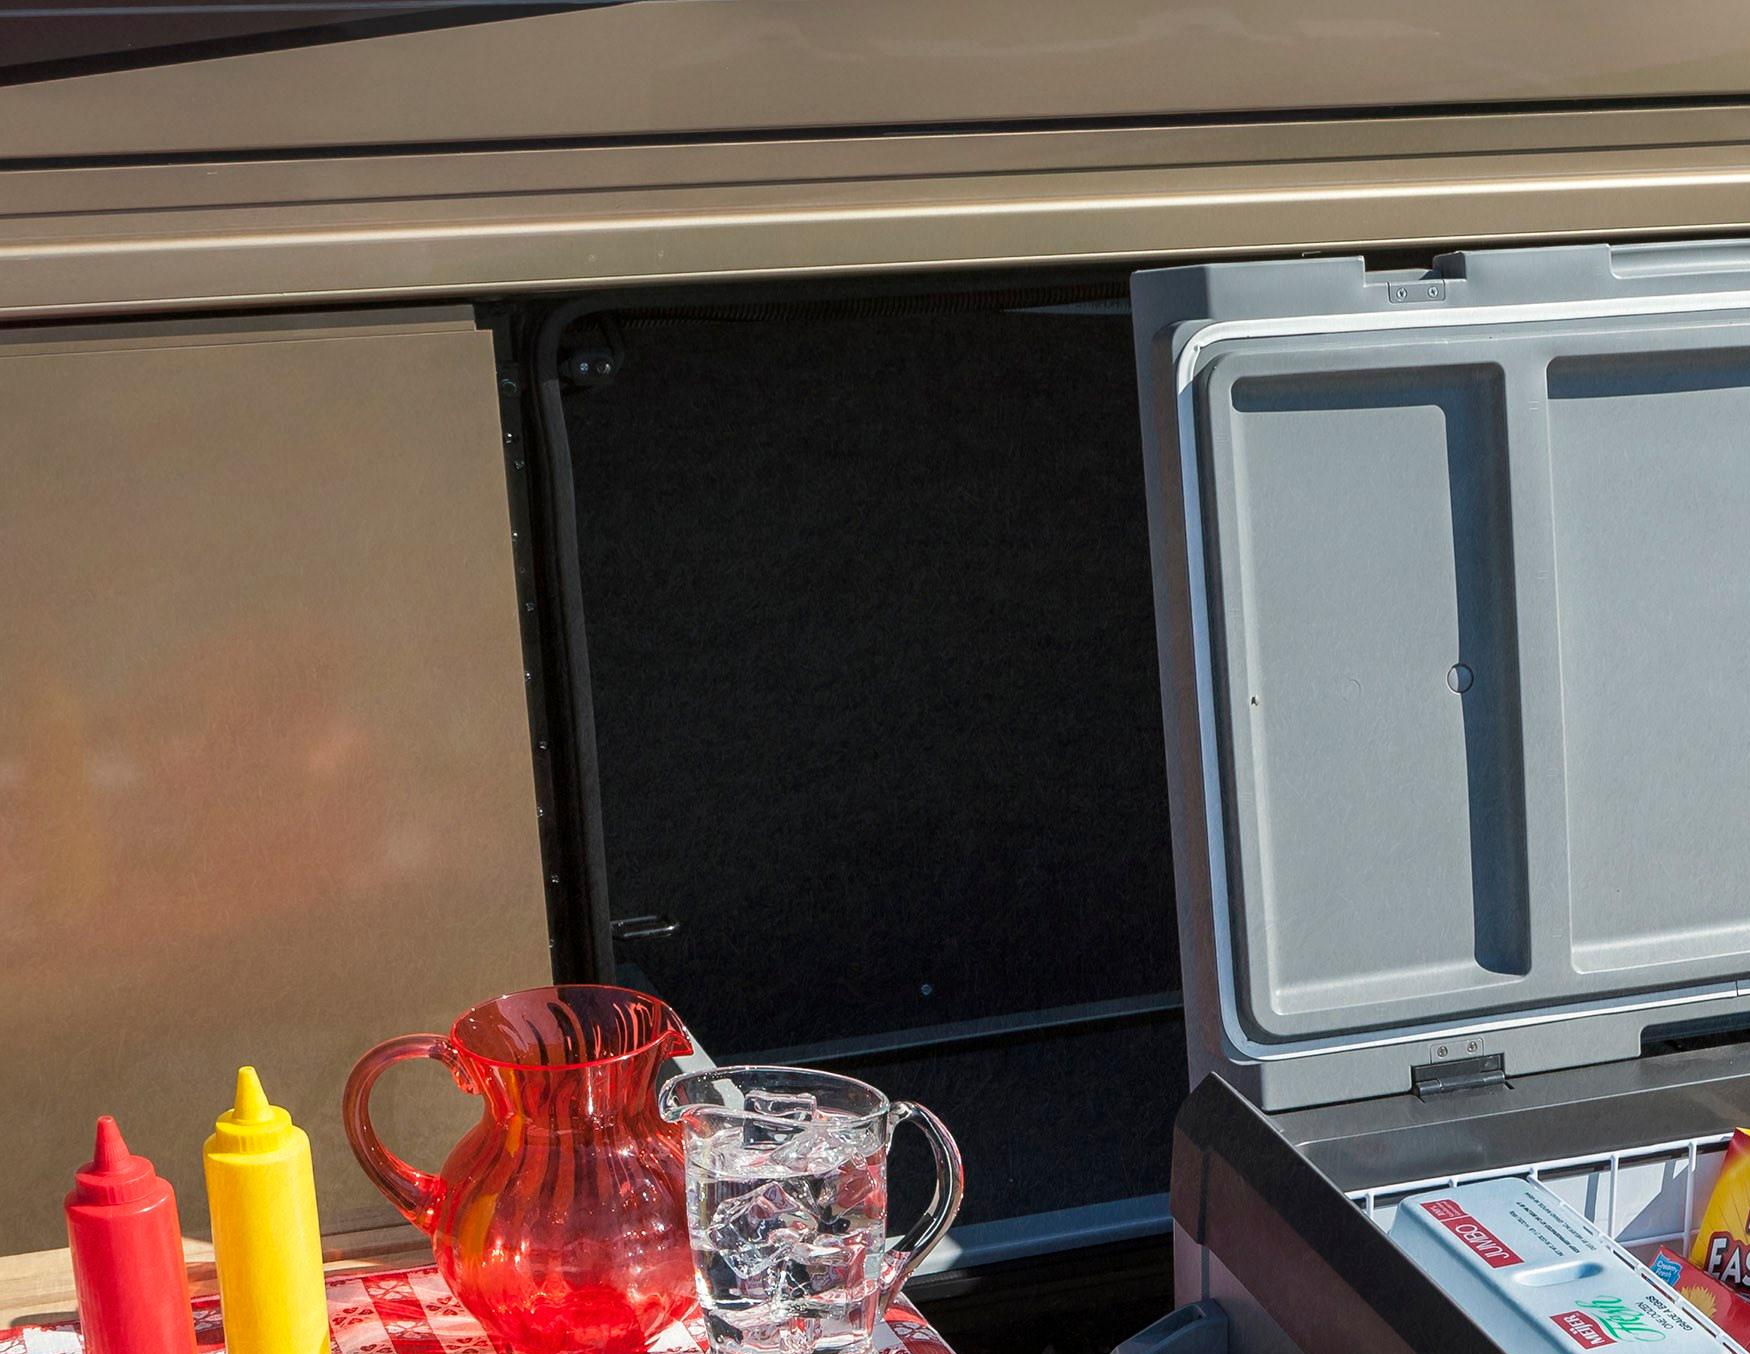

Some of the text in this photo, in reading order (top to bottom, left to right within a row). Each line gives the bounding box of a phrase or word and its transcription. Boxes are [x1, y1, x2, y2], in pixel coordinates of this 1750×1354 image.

[1456, 1224, 1510, 1260] JUMBO
[1563, 1314, 1605, 1345] MEIJER
[1636, 1301, 1674, 1330] ONE DOZEN
[1668, 1313, 1693, 1332] GRADE
